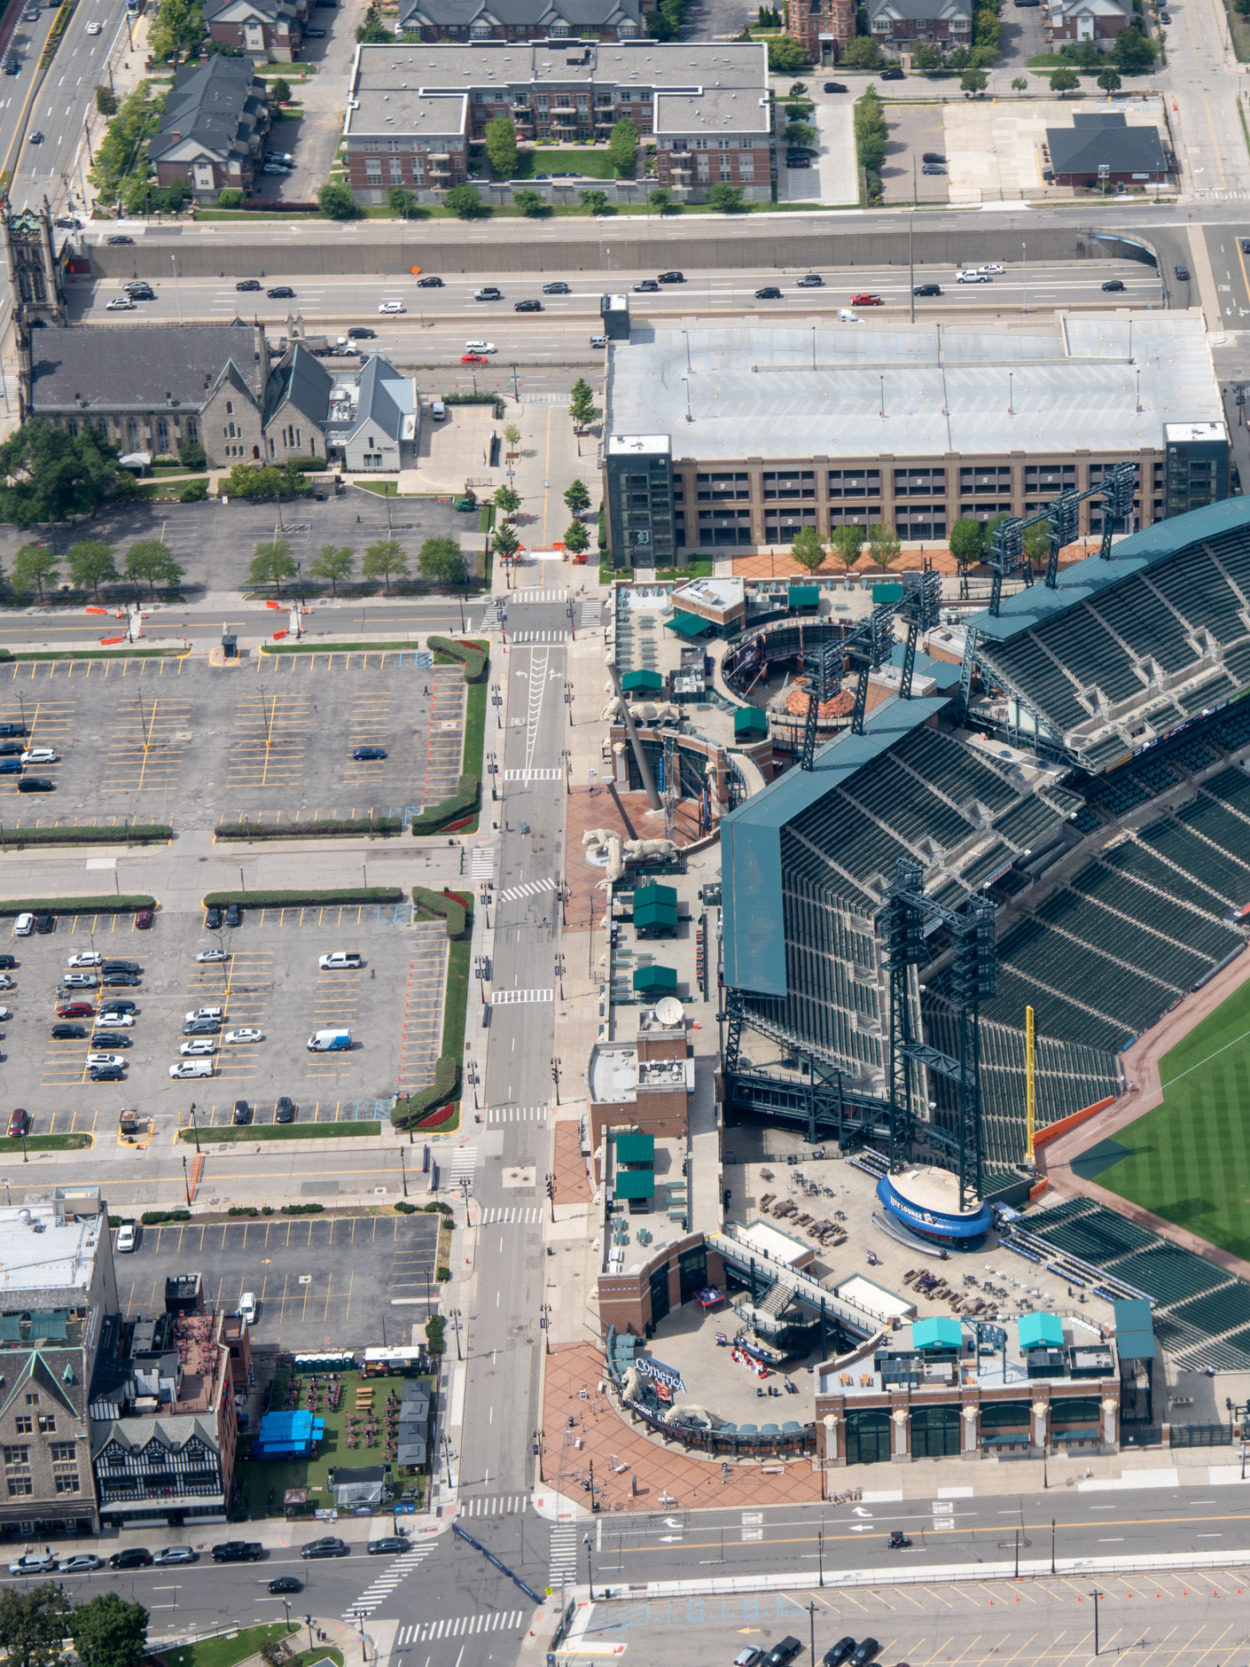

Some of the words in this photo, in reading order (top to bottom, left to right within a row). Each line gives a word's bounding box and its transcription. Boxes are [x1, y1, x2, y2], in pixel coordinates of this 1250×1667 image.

[511, 717, 525, 727] ONLY
[901, 1205, 923, 1221] LOUNGE
[628, 1399, 654, 1418] ocket
